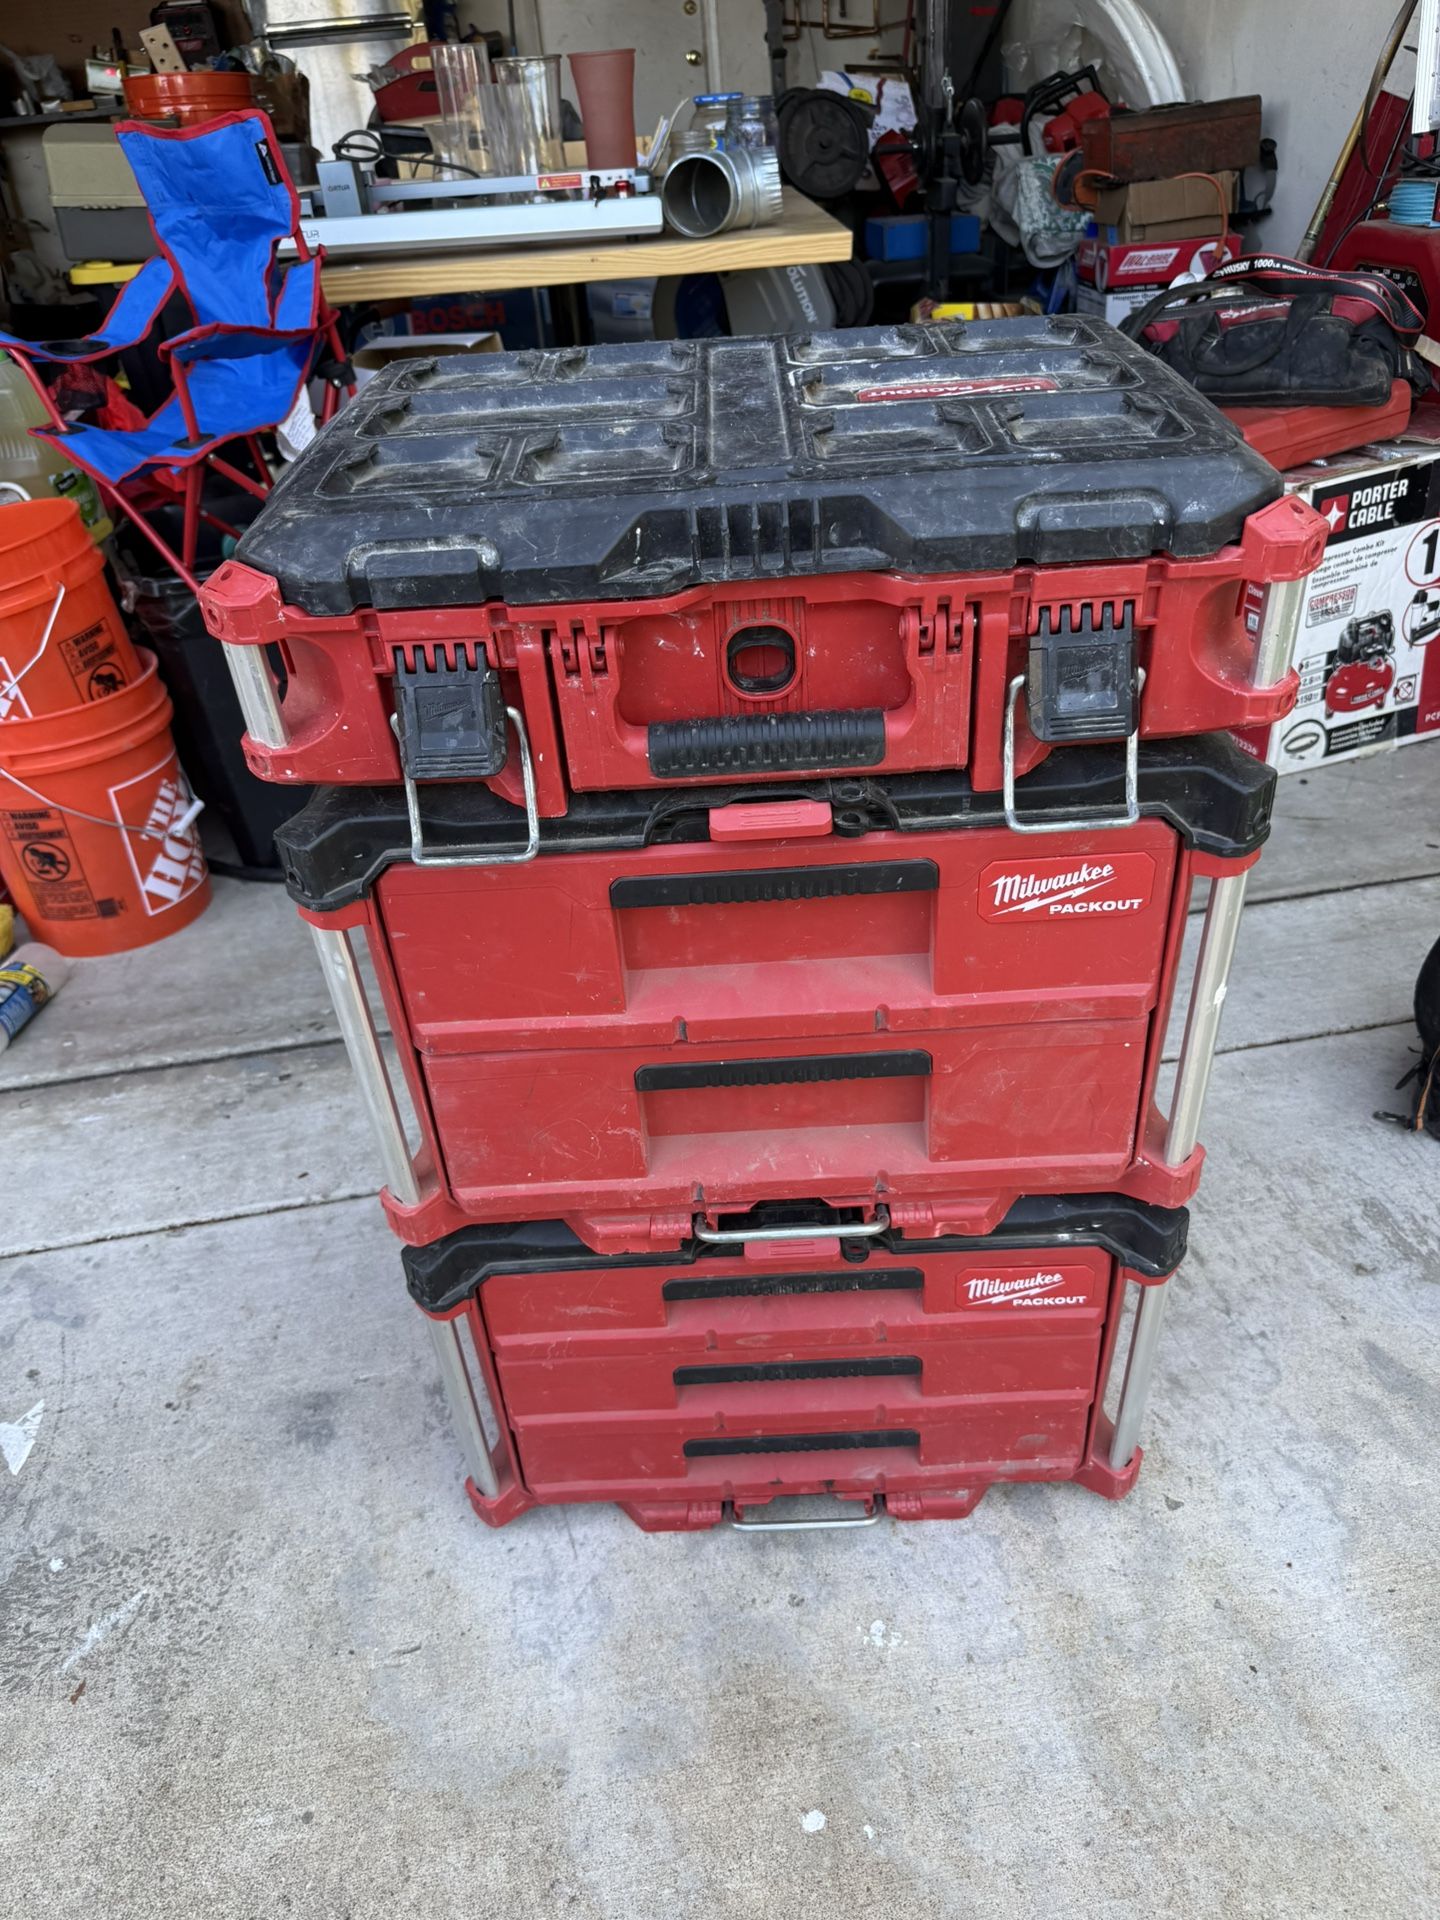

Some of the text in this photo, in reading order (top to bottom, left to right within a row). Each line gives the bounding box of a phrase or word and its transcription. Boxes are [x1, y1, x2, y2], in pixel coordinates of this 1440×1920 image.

[300, 229, 320, 239] TUR
[1223, 261, 1250, 275] HUSKY
[786, 265, 818, 323] OLUTION
[411, 302, 506, 334] BOSCH
[867, 385, 973, 398] PACKOUT
[1351, 478, 1409, 510] PORTER
[1348, 500, 1395, 529] CABLE
[1352, 543, 1374, 555] Combo
[140, 778, 177, 840] THE
[988, 863, 1115, 906] Milwaukee
[1049, 898, 1143, 914] PACKOUT
[963, 1272, 1064, 1299] Milwaukee
[1012, 1295, 1087, 1306] PACKOUT
